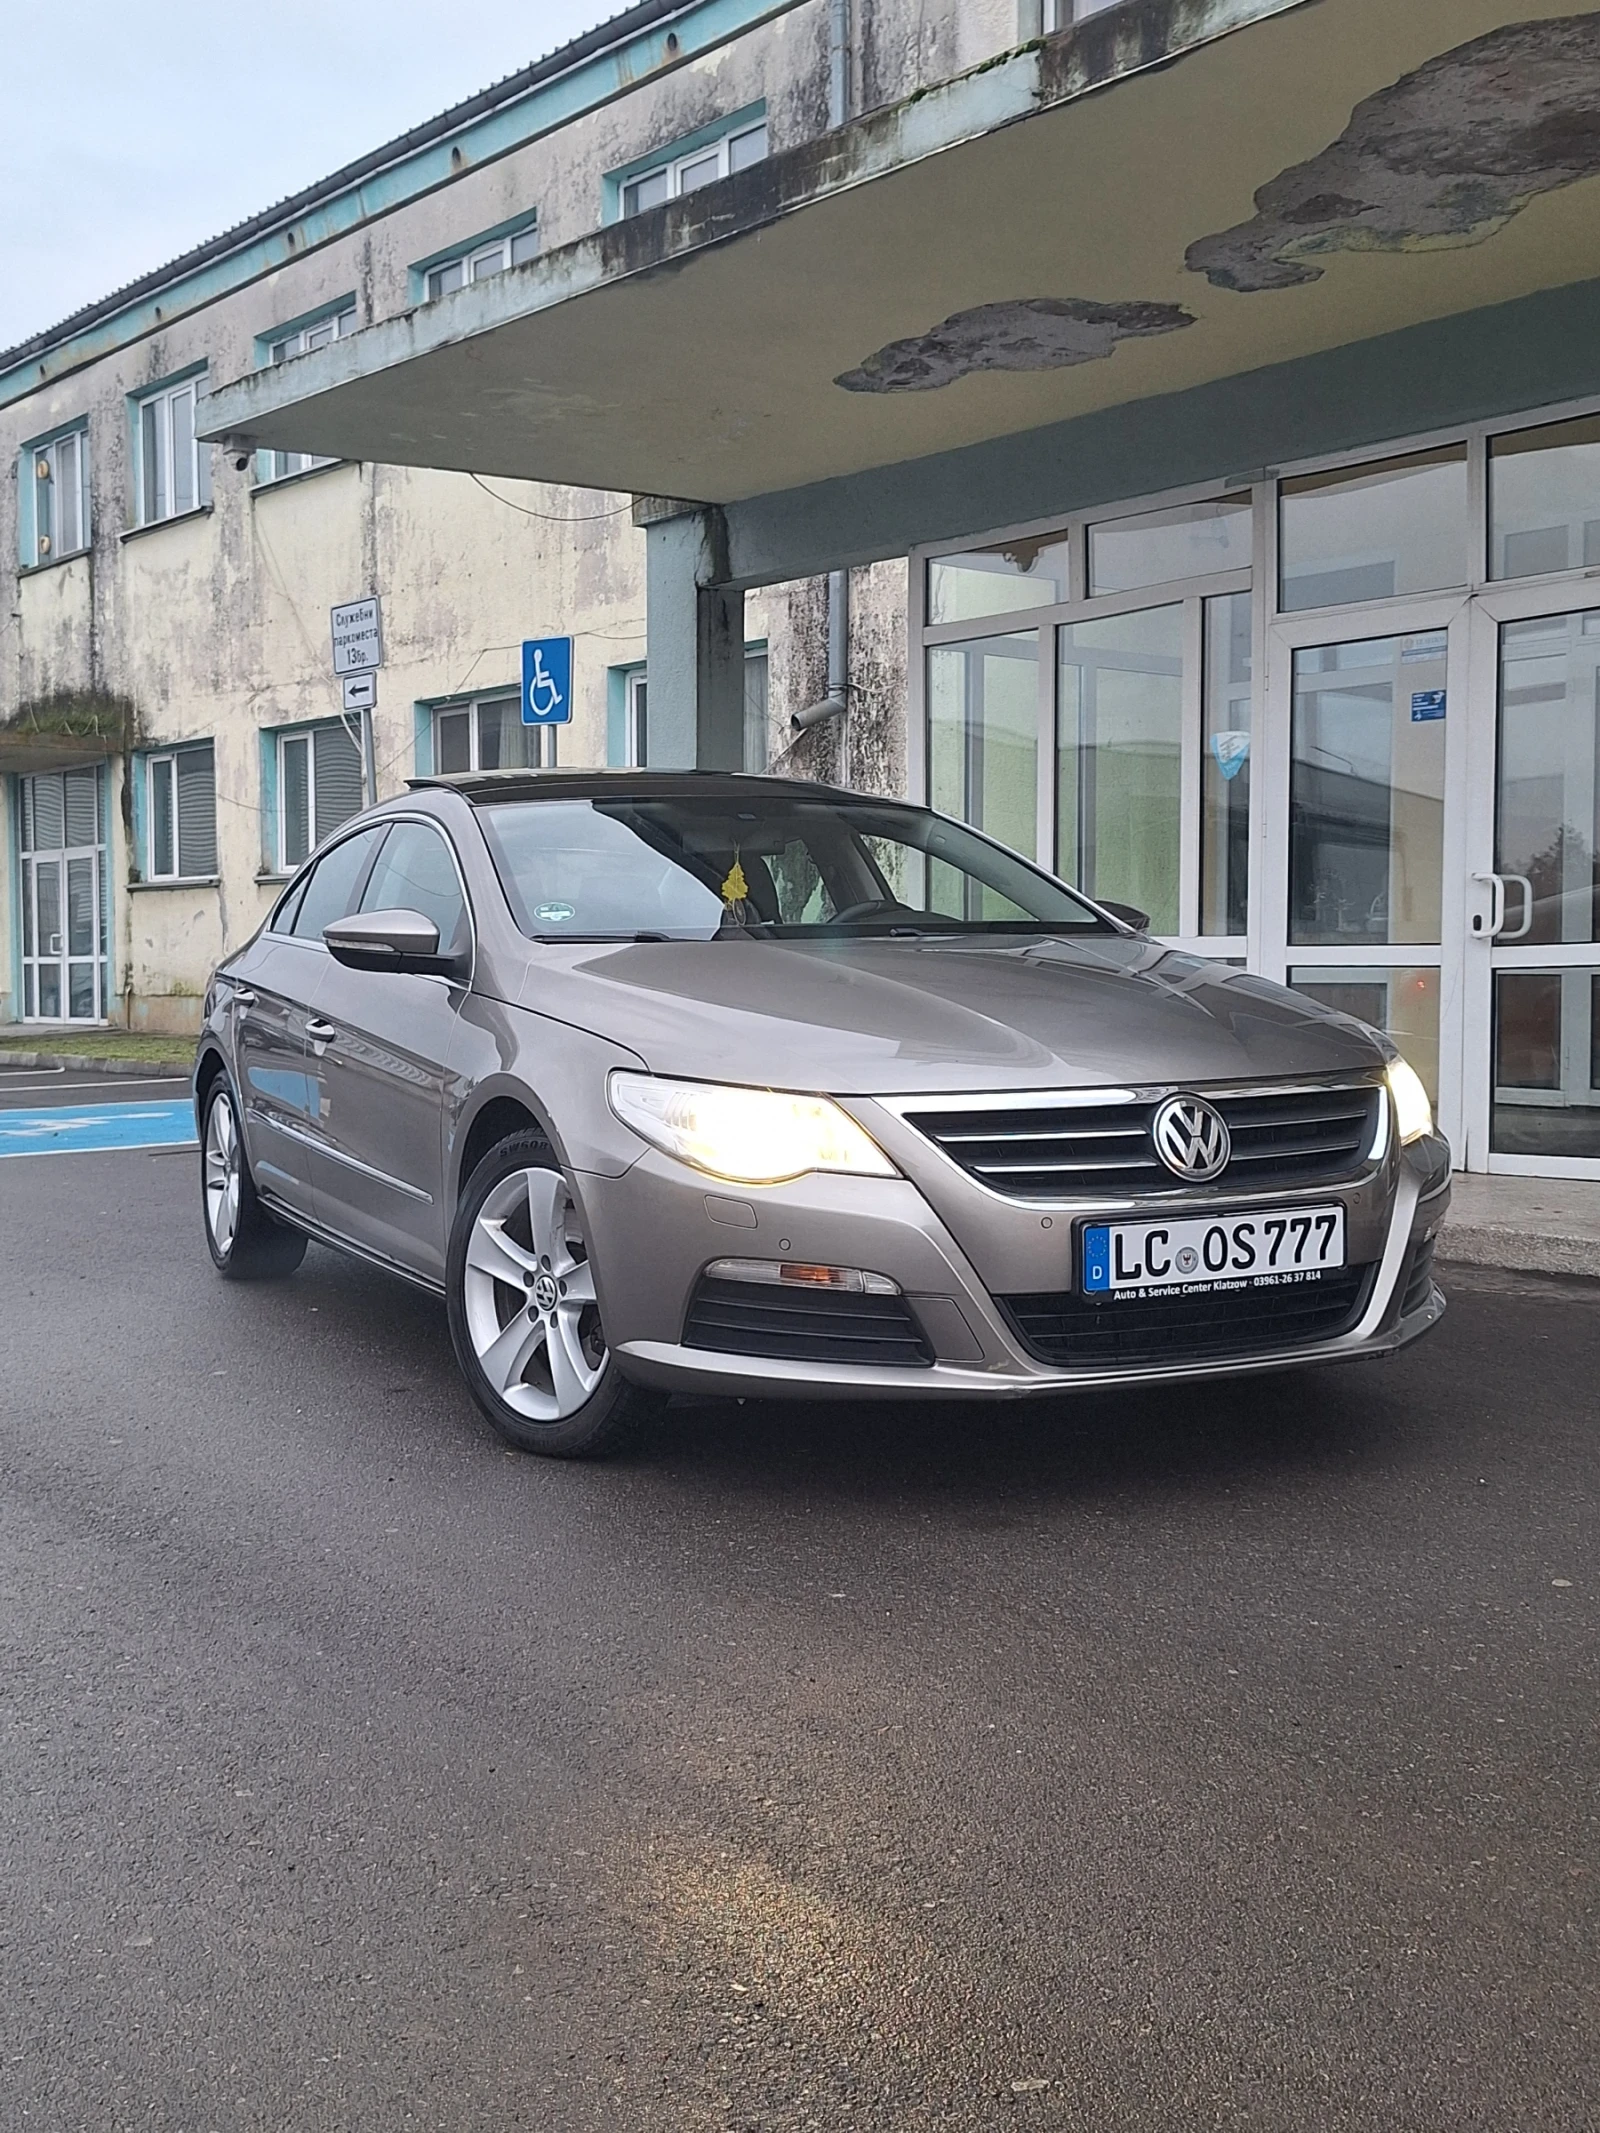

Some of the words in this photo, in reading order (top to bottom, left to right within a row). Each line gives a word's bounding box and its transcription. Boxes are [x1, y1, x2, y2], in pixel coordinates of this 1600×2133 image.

[500, 1140, 549, 1157] SW608
[1115, 1229, 1171, 1281] LC
[1092, 1265, 1103, 1280] D
[1113, 1290, 1137, 1301] Auto
[1138, 1288, 1146, 1298] &
[1148, 1284, 1180, 1296] Service
[1182, 1282, 1212, 1294] Center
[1213, 1279, 1248, 1291] Klatzow
[1254, 1275, 1292, 1287] 03961-26
[1294, 1273, 1304, 1282] 37
[1306, 1271, 1321, 1280] 814
